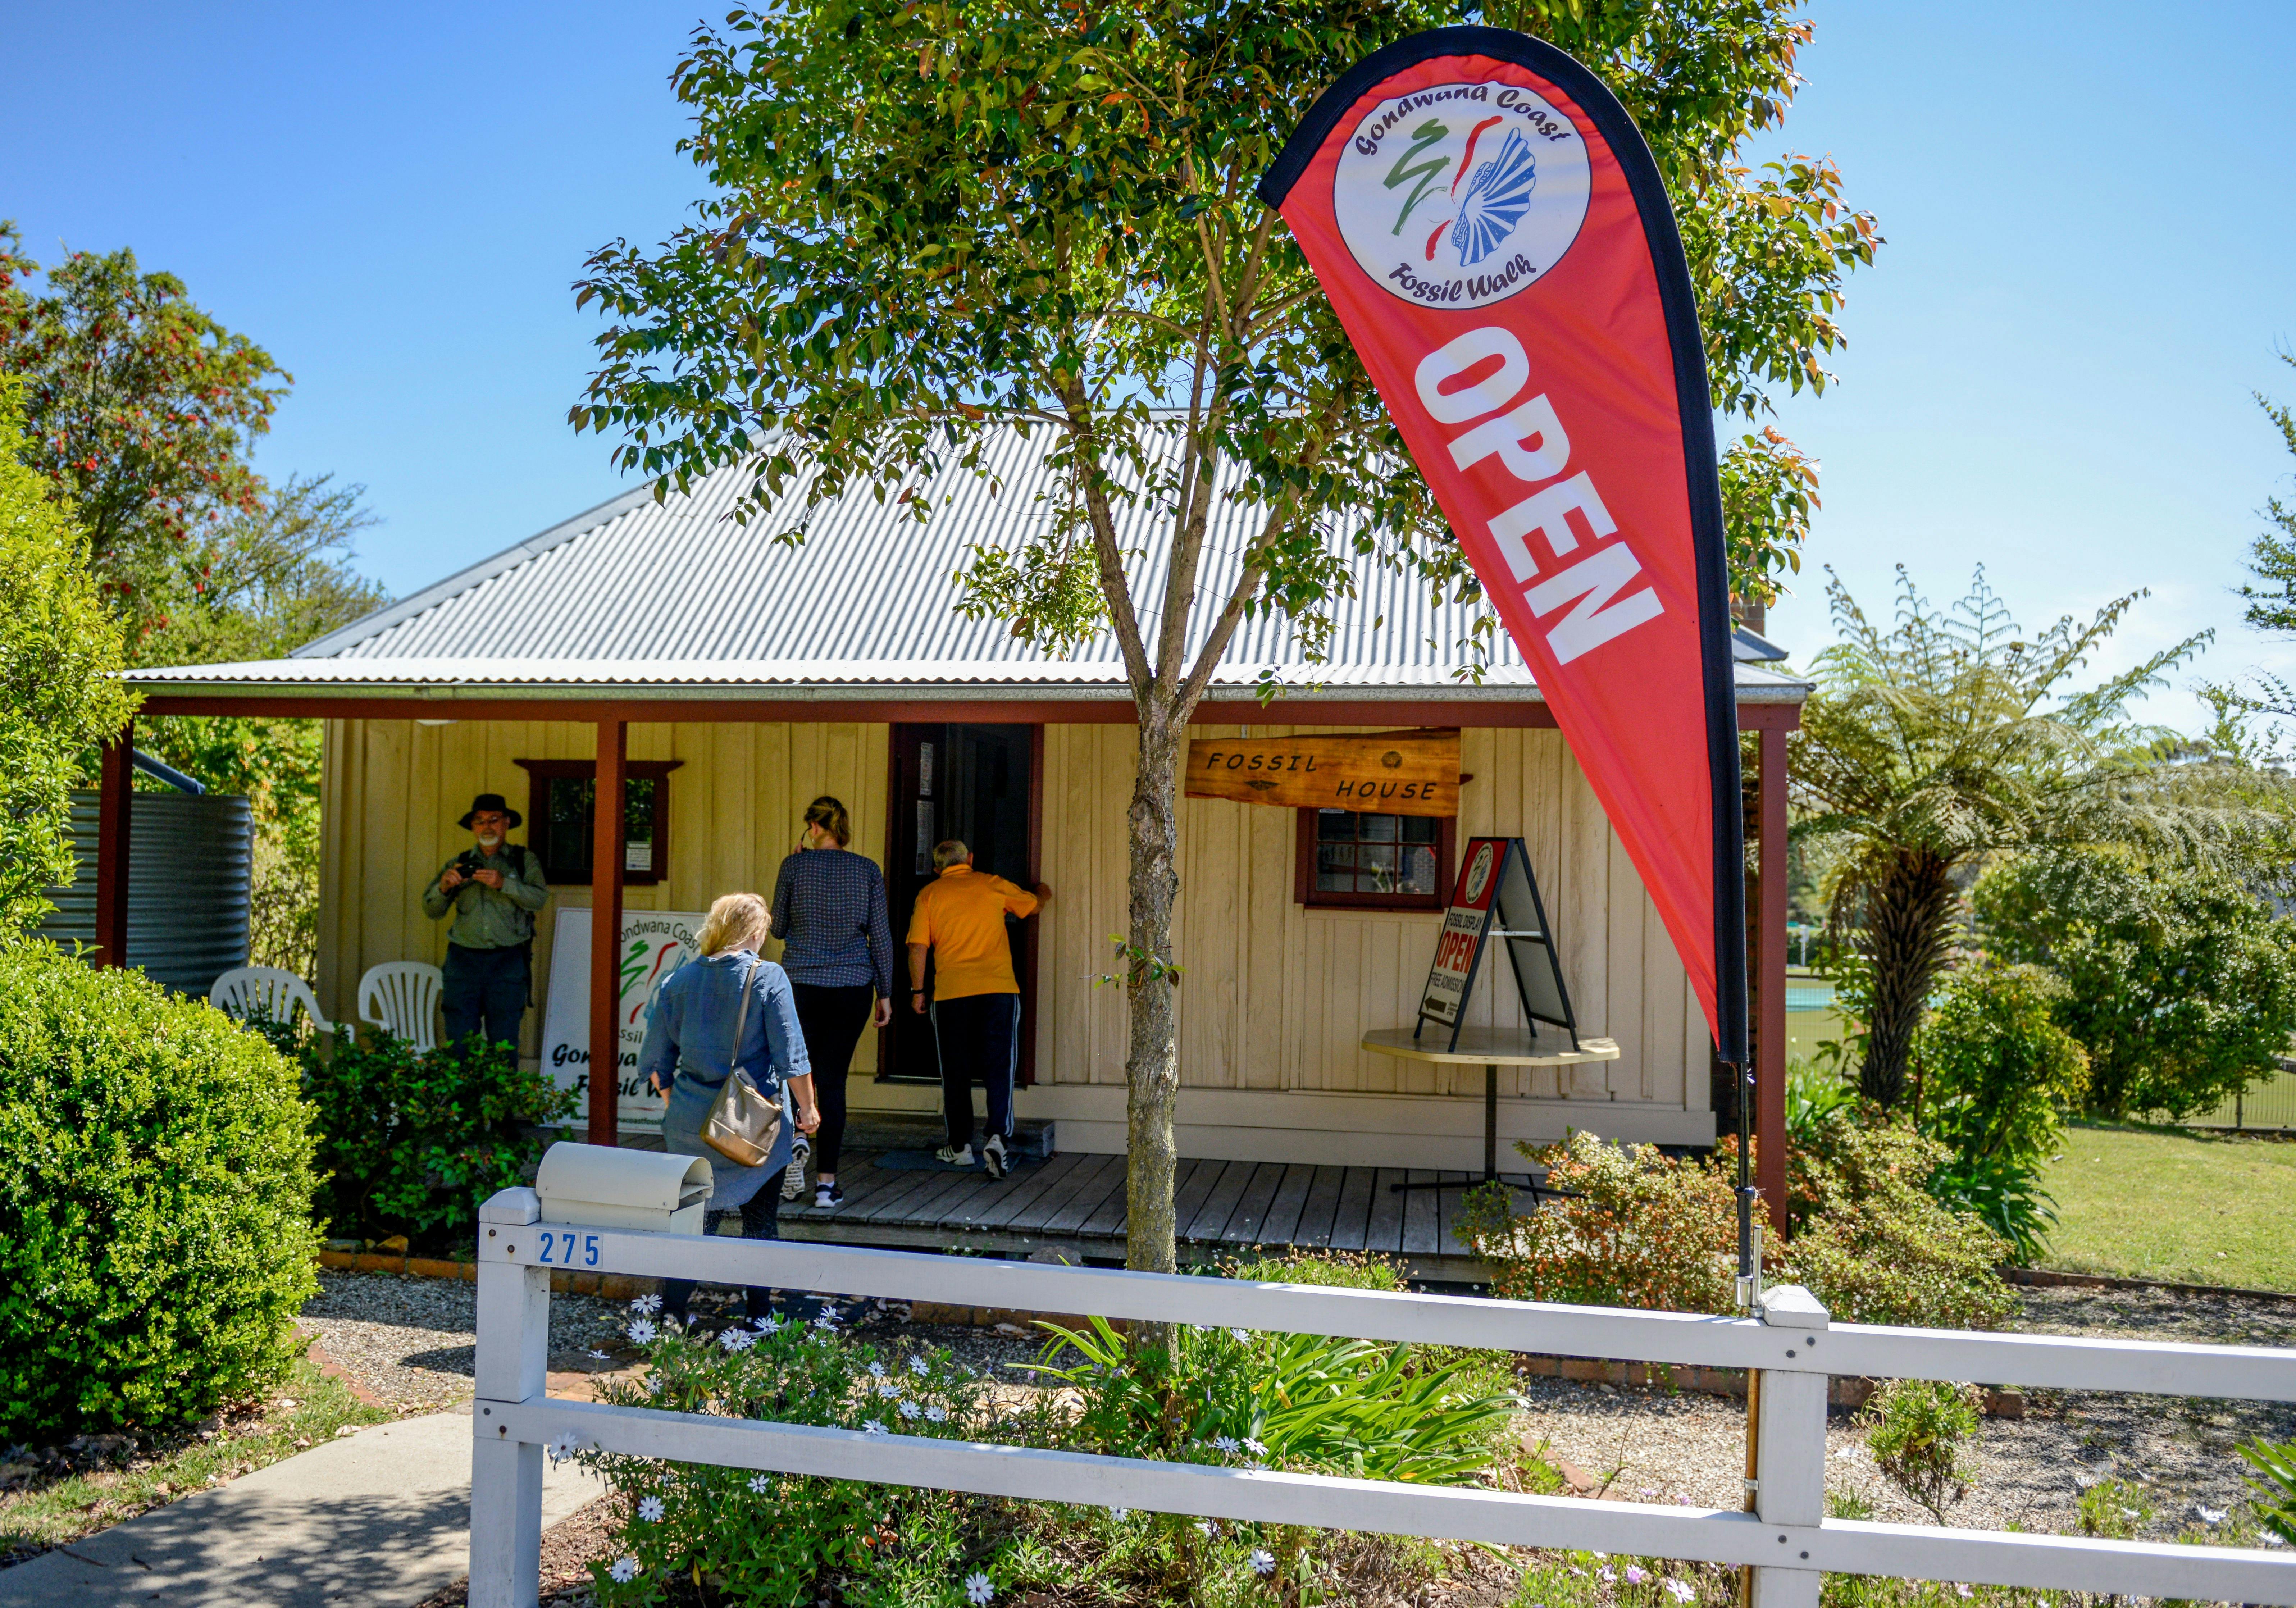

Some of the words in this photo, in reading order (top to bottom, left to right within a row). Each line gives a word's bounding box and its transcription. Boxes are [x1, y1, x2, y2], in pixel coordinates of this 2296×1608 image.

[1355, 85, 1488, 156] Gondwana
[1496, 89, 1571, 142] Coast
[1388, 262, 1463, 302] Fossil
[1466, 254, 1537, 301] Walk
[1414, 326, 1665, 666] OPEN
[1207, 752, 1317, 772] FOSSIL
[1336, 780, 1438, 800] HOUSE
[620, 919, 670, 943] ondwana
[1448, 912, 1464, 928] FOSSIL
[1462, 915, 1484, 931] DISPLAY
[1436, 930, 1478, 974] OPEN
[1429, 971, 1443, 987] FREE
[619, 1029, 643, 1044] ssil
[539, 1232, 599, 1266] 275
